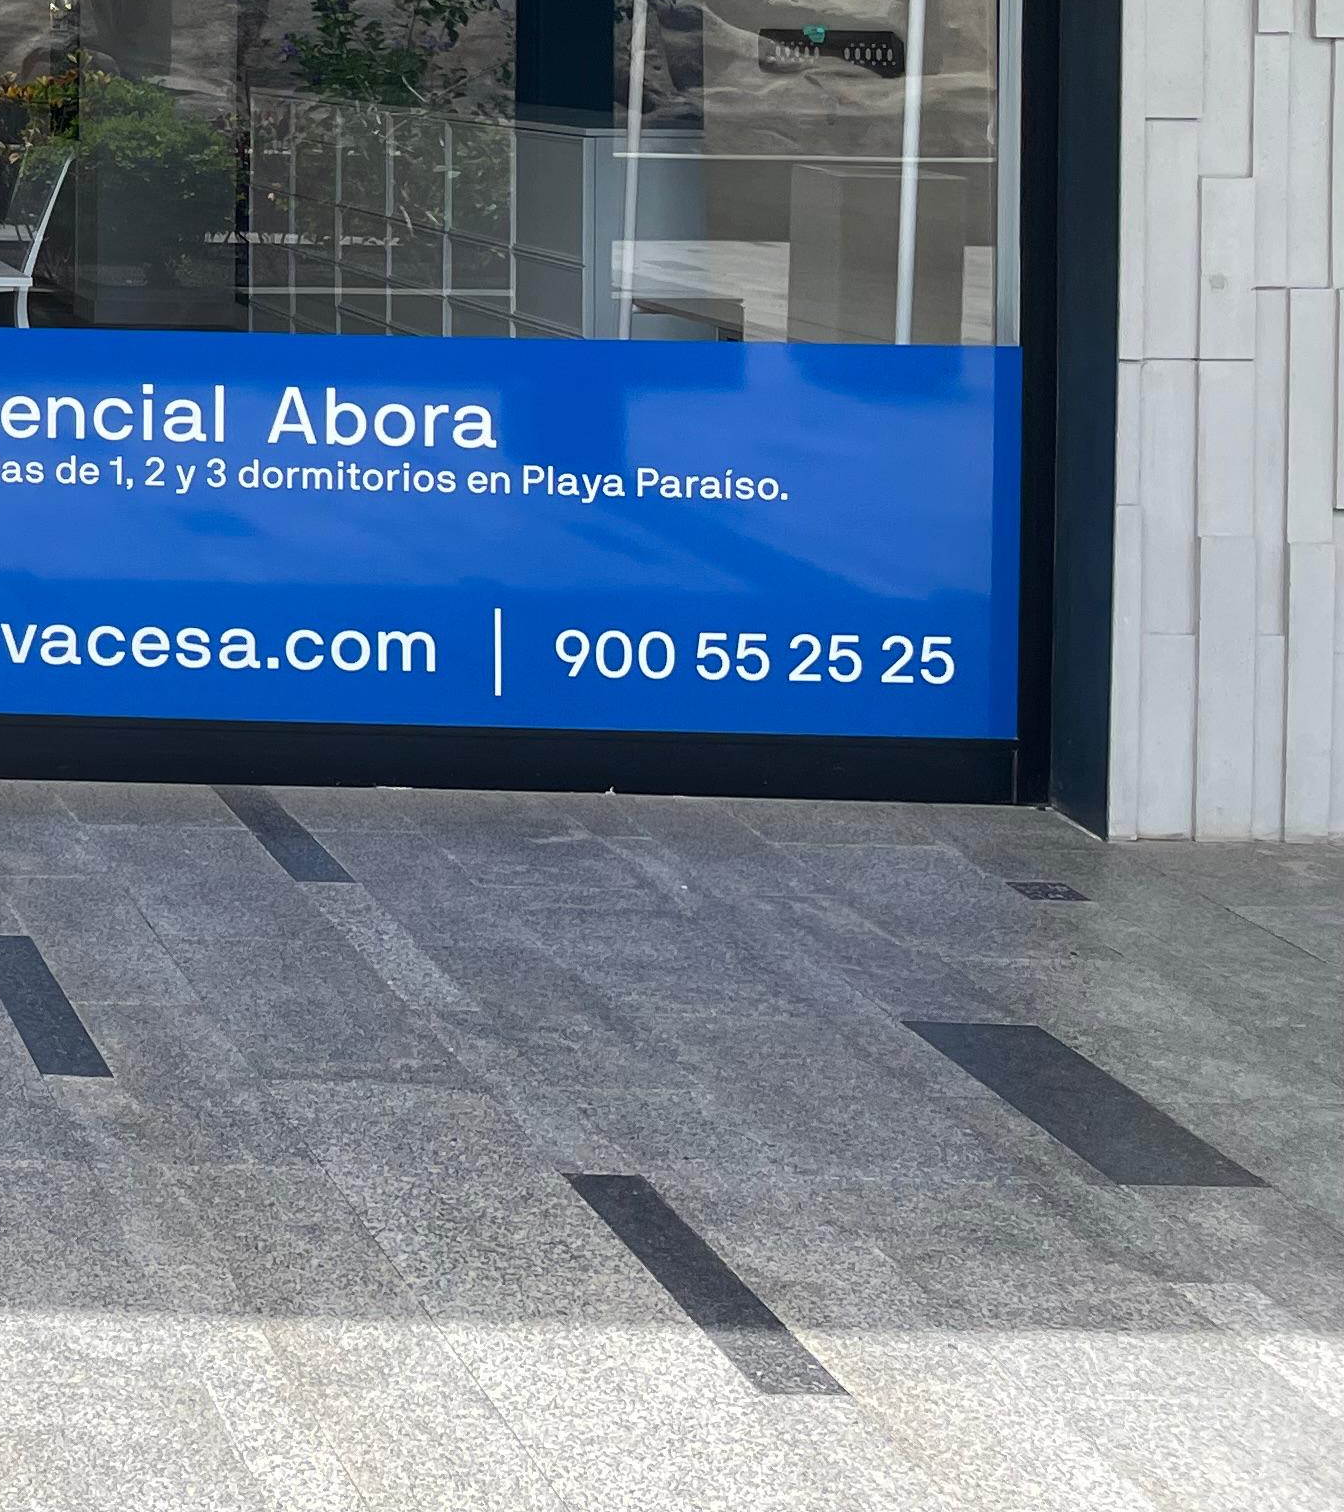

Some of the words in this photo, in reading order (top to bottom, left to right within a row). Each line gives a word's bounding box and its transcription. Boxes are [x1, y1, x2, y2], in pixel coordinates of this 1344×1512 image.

[267, 386, 497, 449] Abora
[55, 454, 100, 485] de
[109, 456, 134, 490] 1,
[144, 456, 165, 487] 2
[175, 464, 196, 494] y
[206, 457, 227, 488] 3
[238, 458, 457, 493] dormitorios
[467, 471, 511, 494] en
[523, 465, 626, 504] Playa
[637, 467, 788, 501] Paraíso.
[555, 629, 675, 680] 900
[696, 632, 770, 681] 55
[788, 633, 862, 683] 25
[881, 635, 955, 685] 25
